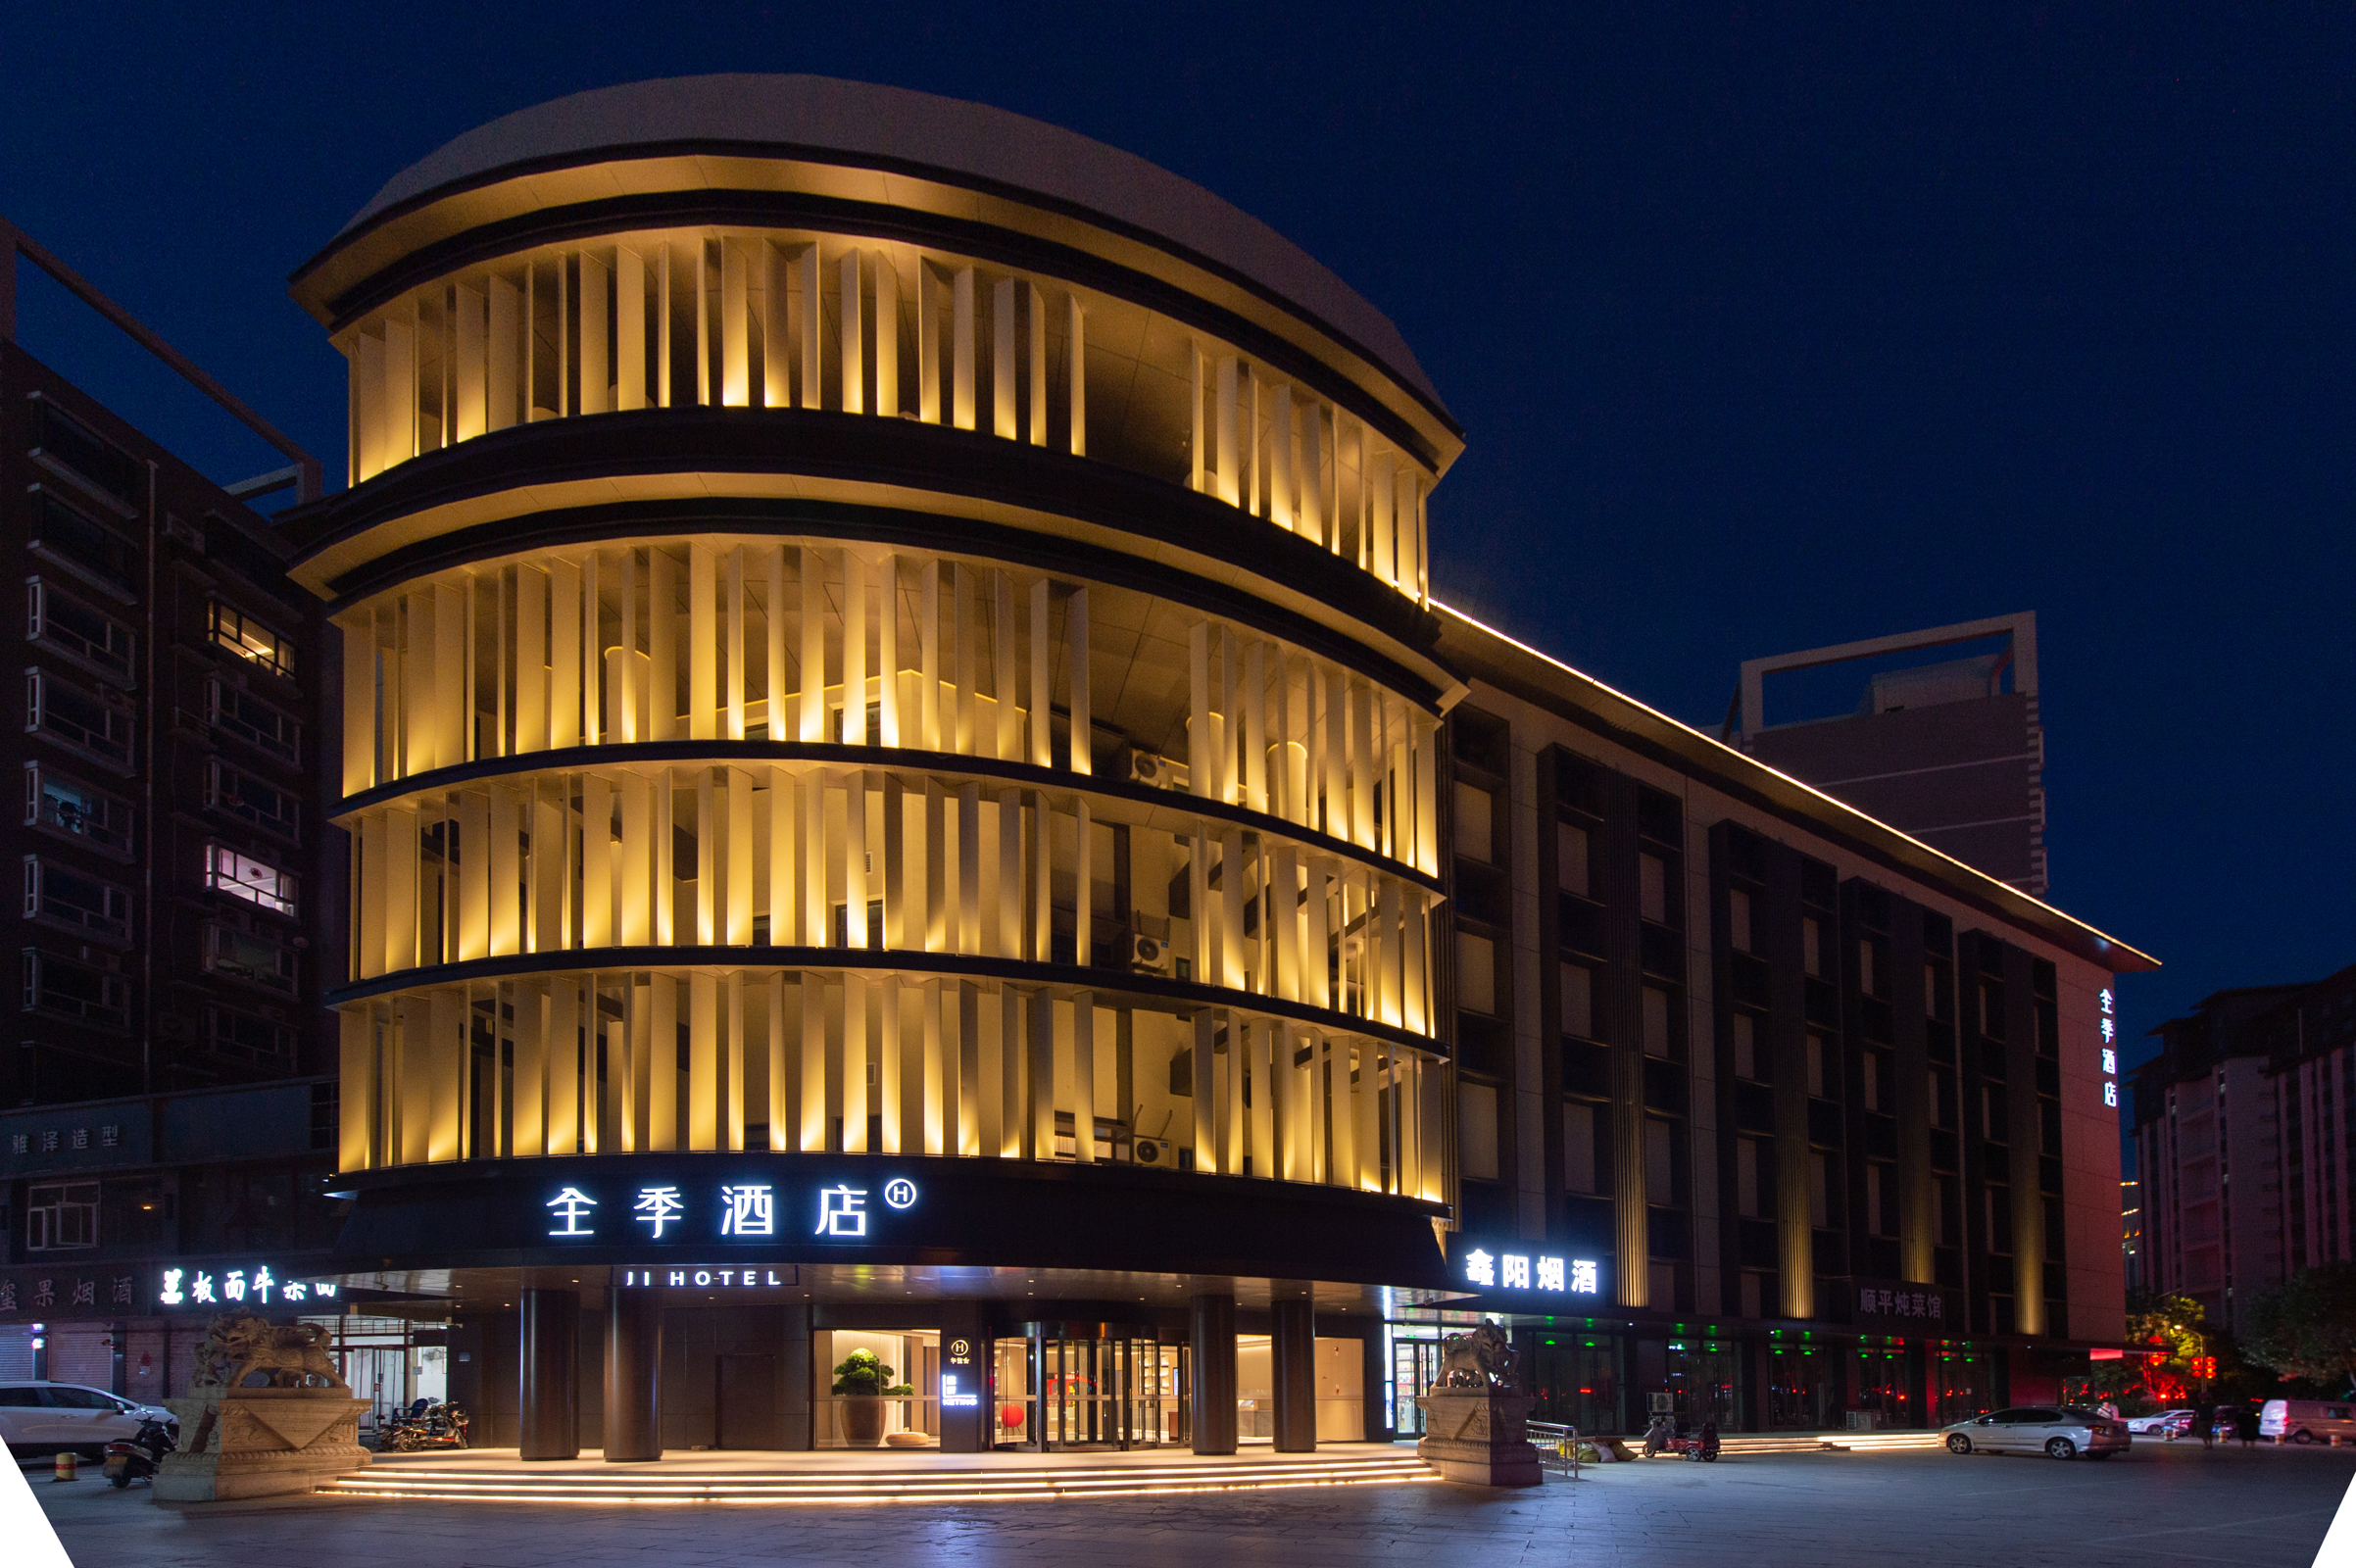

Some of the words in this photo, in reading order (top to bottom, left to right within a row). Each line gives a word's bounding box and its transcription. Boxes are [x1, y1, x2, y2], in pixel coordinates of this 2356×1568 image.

[2099, 989, 2117, 1107] 全季酒店
[13, 1125, 119, 1154] 雅泽造型
[546, 1184, 868, 1239] 全季酒店
[626, 1271, 650, 1287] JI
[669, 1271, 781, 1287] HOTEL
[1465, 1249, 1596, 1294] 鑫阳烟酒
[1860, 1287, 1941, 1319] 顺平炖菜馆
